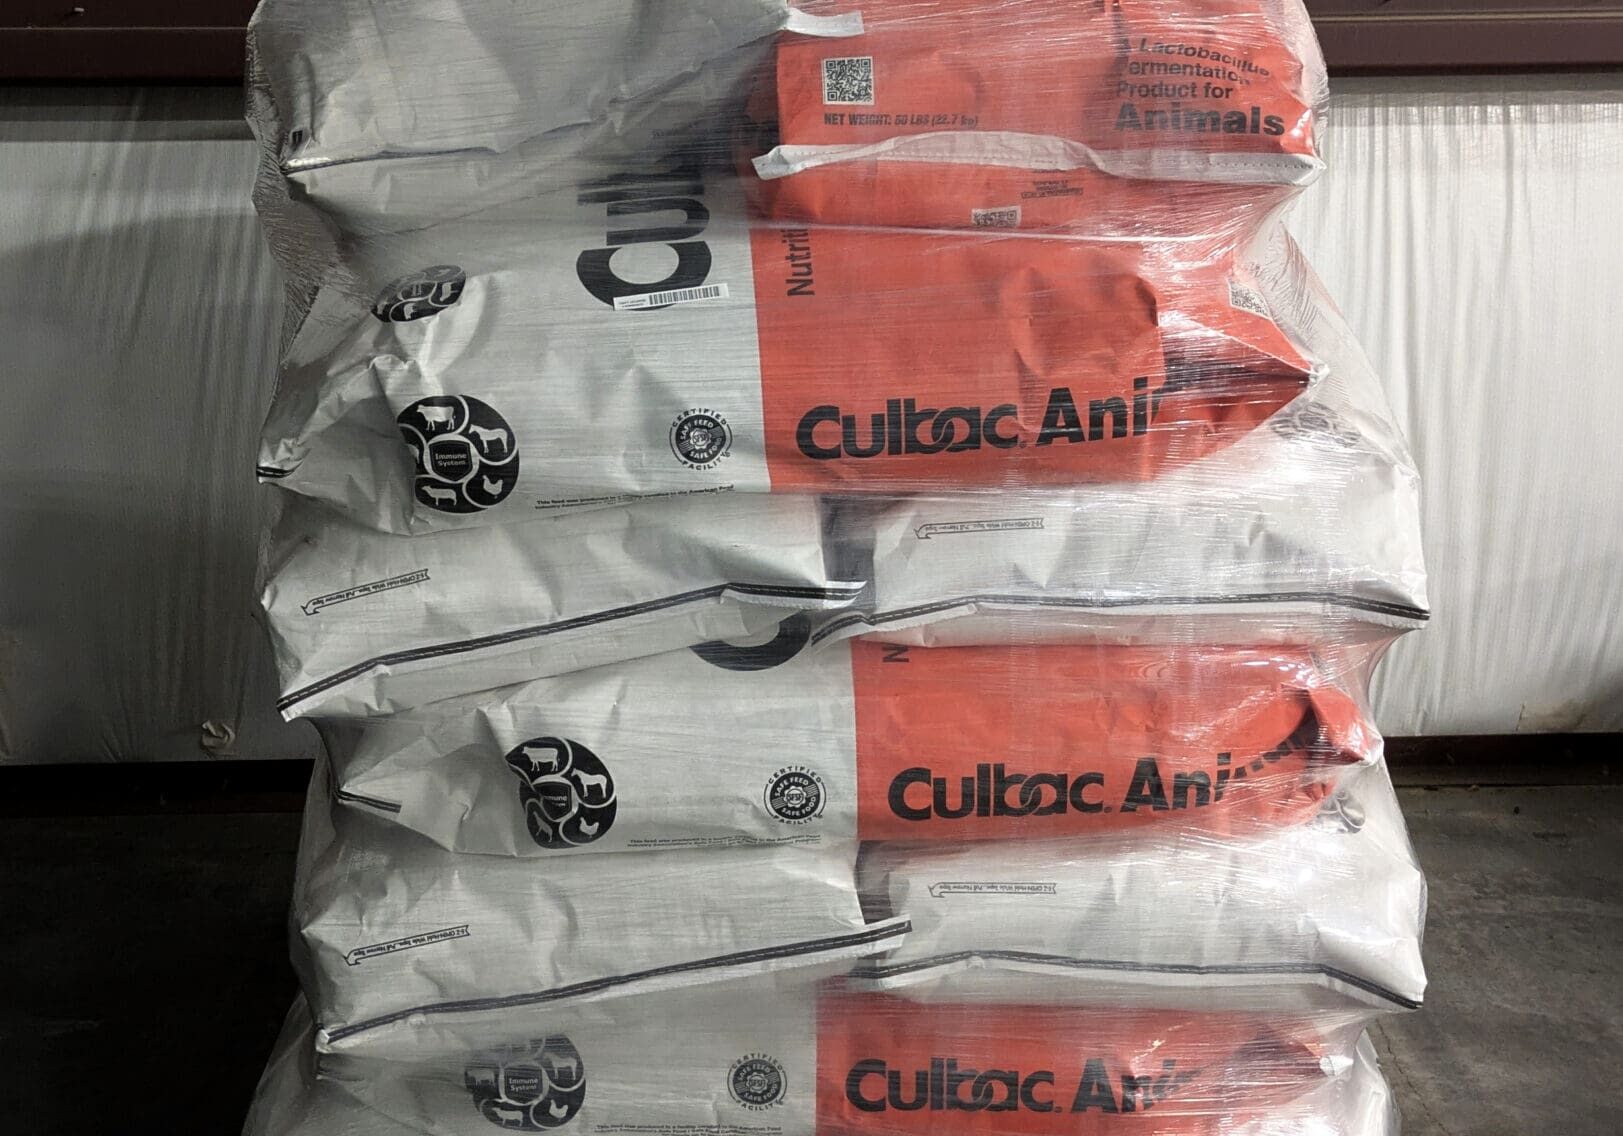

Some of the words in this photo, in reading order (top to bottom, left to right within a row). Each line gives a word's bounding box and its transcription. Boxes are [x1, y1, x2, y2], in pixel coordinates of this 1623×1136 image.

[1140, 37, 1270, 77] Lactobacillus
[1116, 80, 1198, 98] Product
[1203, 81, 1234, 98] for
[824, 112, 846, 126] NET
[848, 112, 892, 126] WEIGHT:
[910, 113, 930, 126] LBS
[1115, 103, 1286, 136] Animals
[768, 765, 822, 784] CERTIFIED
[510, 1084, 537, 1092] System
